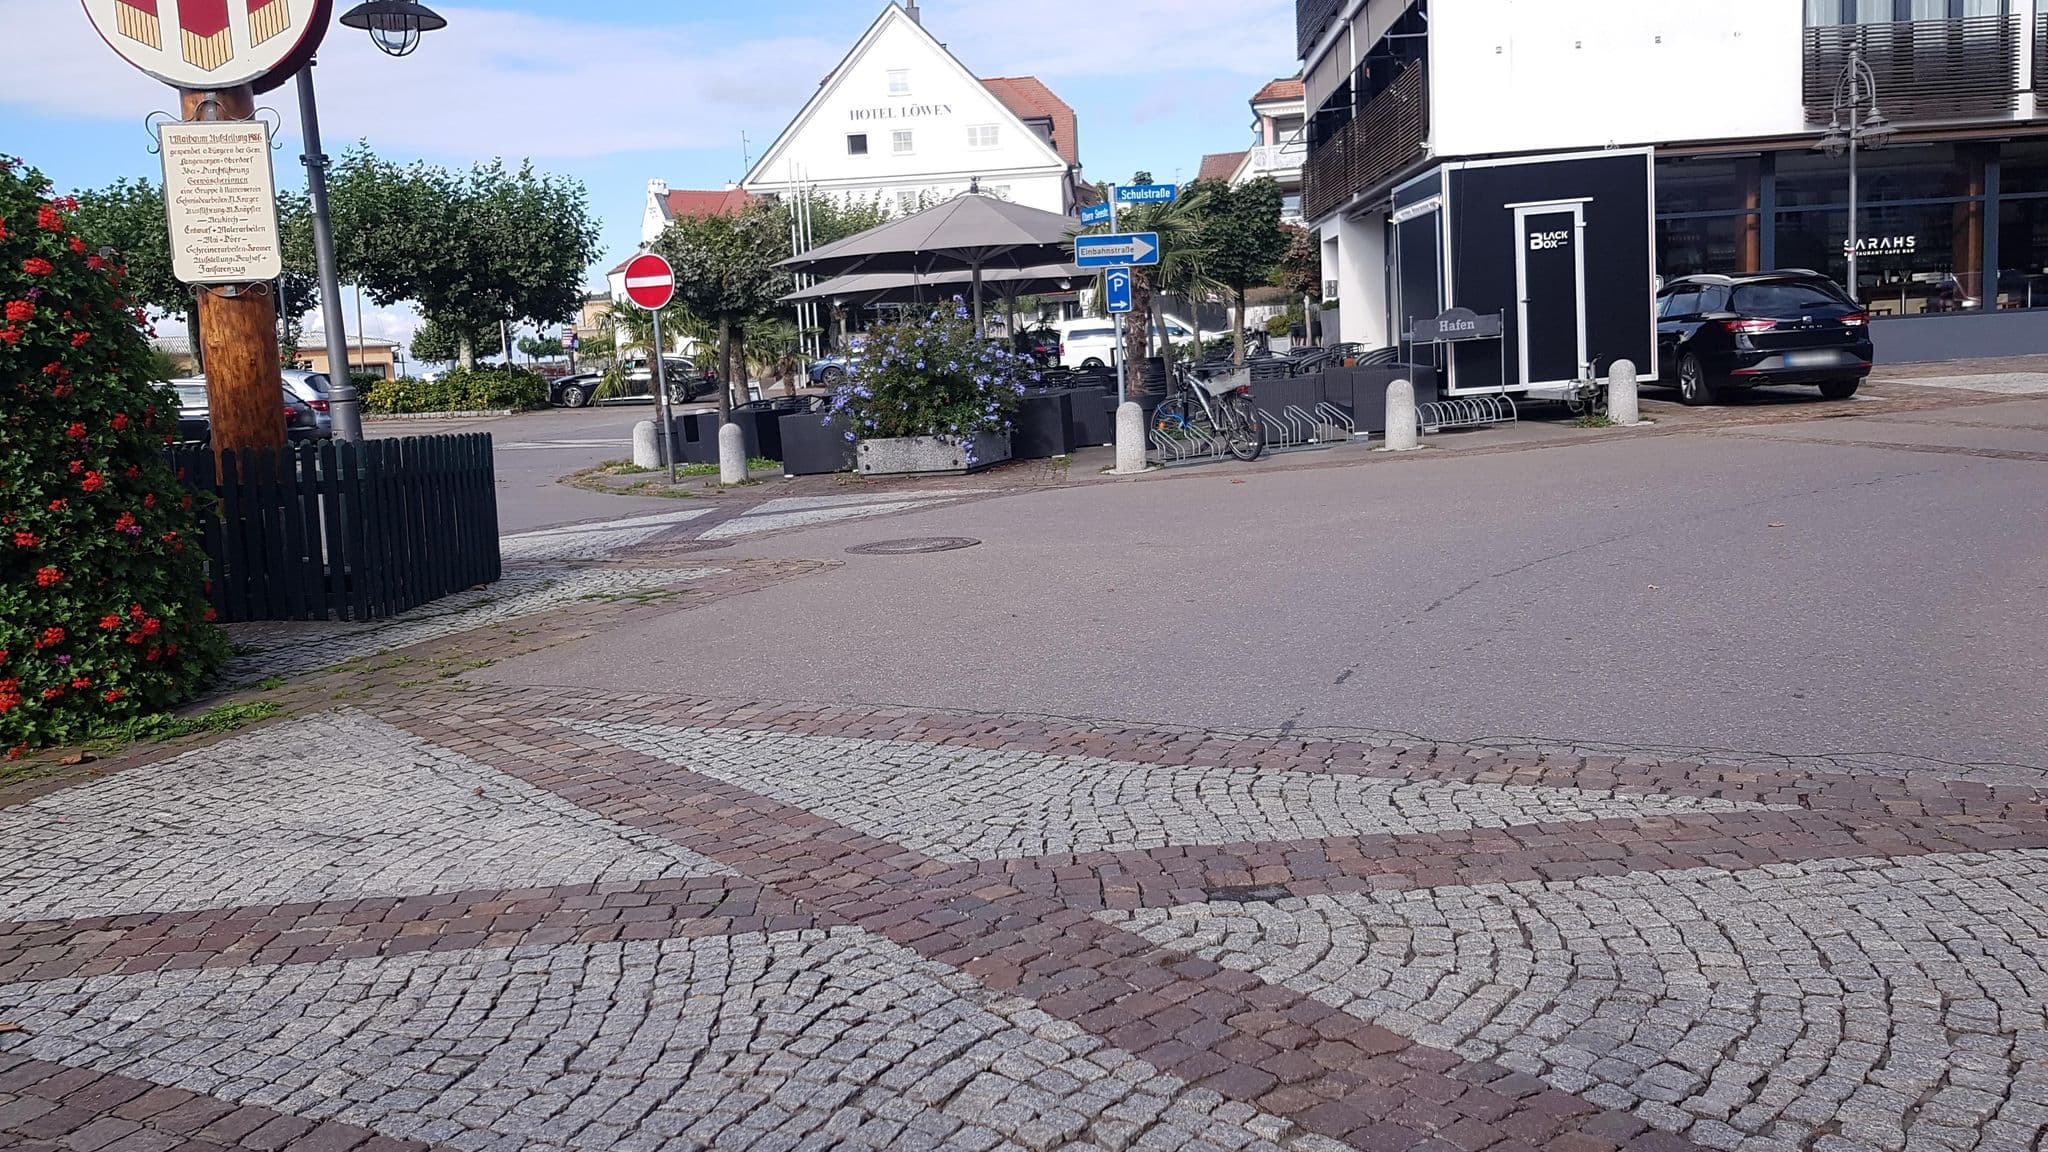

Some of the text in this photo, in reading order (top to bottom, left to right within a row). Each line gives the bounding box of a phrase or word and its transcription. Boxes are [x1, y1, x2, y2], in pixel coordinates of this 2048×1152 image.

[850, 104, 952, 120] HOTEL LÖWEN
[170, 147, 200, 157] gespendet
[194, 186, 218, 194] Gruppe
[1121, 188, 1170, 200] Schulstraße
[217, 224, 266, 234] Malerarbeiten
[1844, 236, 1916, 251] SARAHS
[1080, 246, 1134, 256] Einbahnstraße
[198, 264, 246, 274] Fanfarenzug
[1113, 278, 1124, 292] P
[1439, 319, 1475, 332] Hafen
